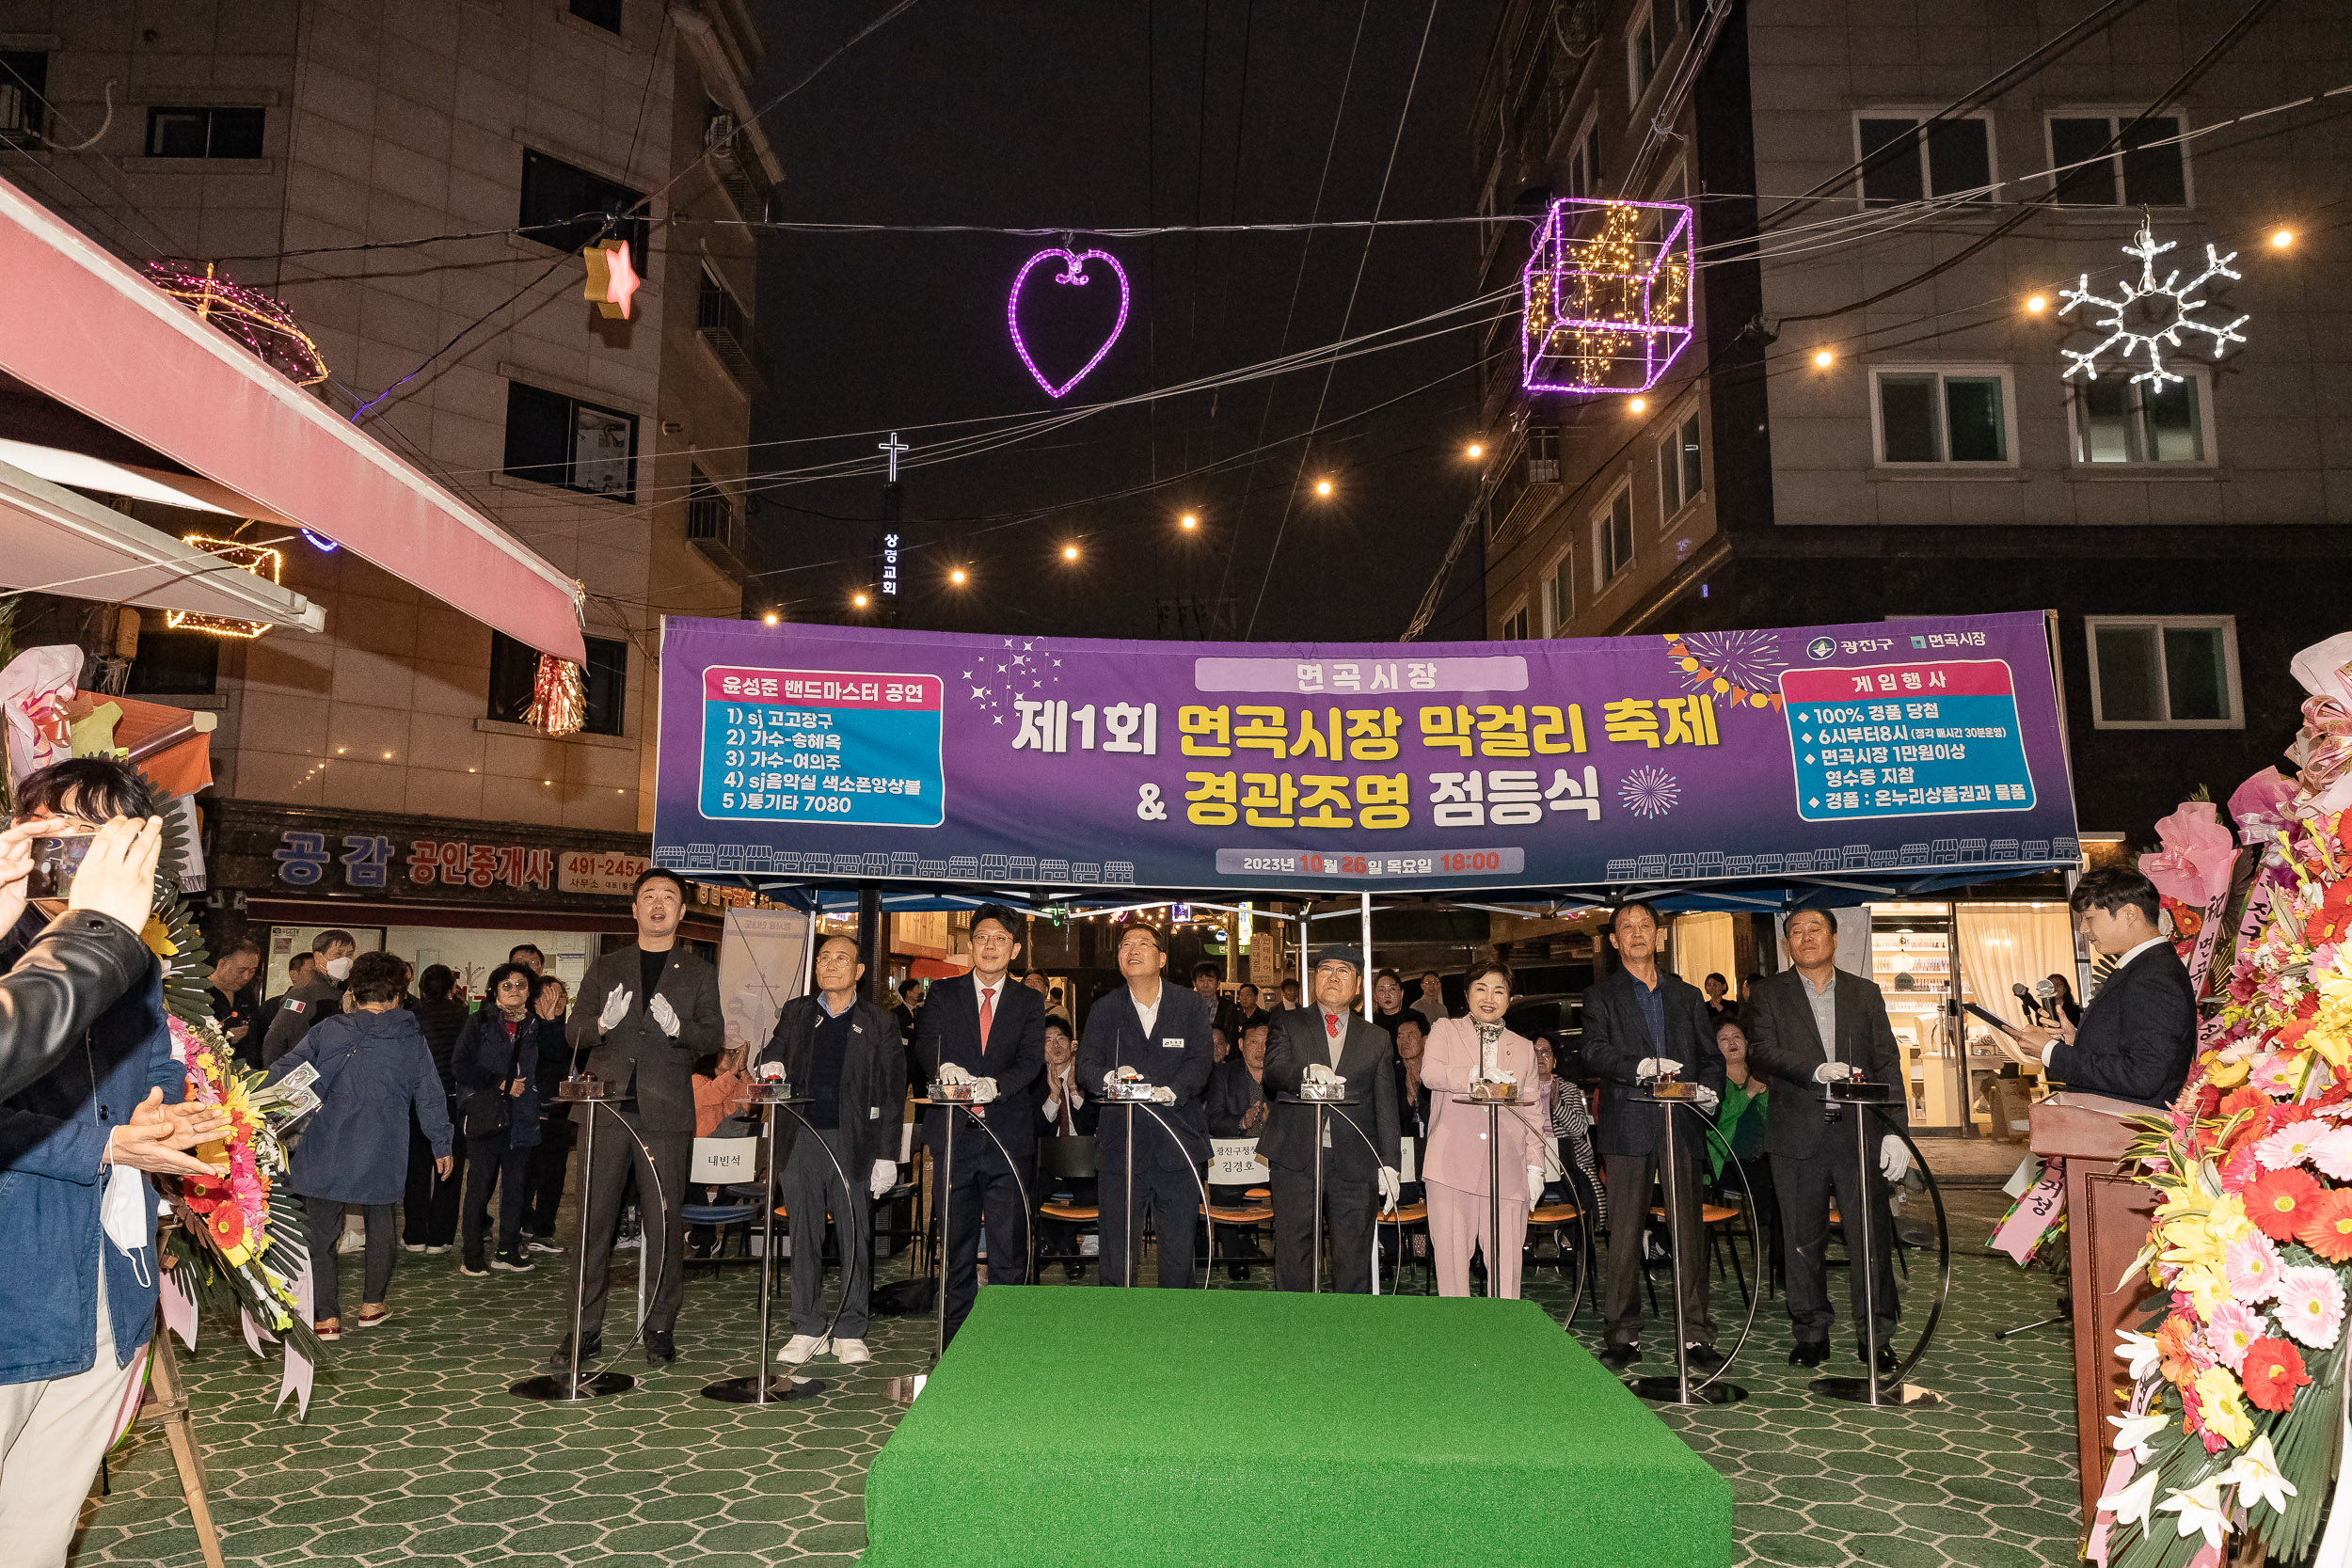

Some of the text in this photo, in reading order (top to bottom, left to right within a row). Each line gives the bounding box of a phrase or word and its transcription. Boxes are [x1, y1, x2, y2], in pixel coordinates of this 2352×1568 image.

[1841, 638, 1895, 654] 광진구
[1928, 632, 1986, 648] 면곡시장
[1296, 660, 1438, 692] 면곡시장
[1851, 670, 1947, 693] 게임행사
[723, 675, 923, 704] 윤성준 밴드마스터 공연
[726, 708, 834, 730] 1) sj 고고장구
[1814, 703, 1939, 724] 100% 경품 당첨
[1011, 693, 1721, 761] 제1회 면곡시장 막걸리 축제
[1818, 725, 2007, 745] 6시부터8시 (정각 매시간 30분운영)
[726, 730, 842, 751] 2) 가수-송혜옥
[725, 750, 842, 770] 3) 가수-여의주
[1821, 742, 1966, 767] 면곡시장 1만원이상
[723, 770, 922, 796] 4) sj음악실 색소폰앙상블
[1825, 767, 1915, 788] 영수증 지참
[803, 796, 851, 813] 7080
[1136, 765, 1601, 830] & 경관조명 점등식
[1825, 791, 1860, 810] 경품
[1874, 784, 1992, 807] 온누리상품권과
[1994, 784, 2027, 801] 물품
[272, 832, 395, 887] 공감
[405, 840, 553, 890] 공인중개사
[568, 856, 644, 877] 491-2454
[1243, 851, 1500, 875] 2023년 10월 26일 목요일 18:00
[569, 879, 599, 889] 사무소
[2205, 892, 2226, 922] 祝
[707, 1154, 741, 1167] 내빈석
[1222, 1161, 1255, 1173] 김경호
